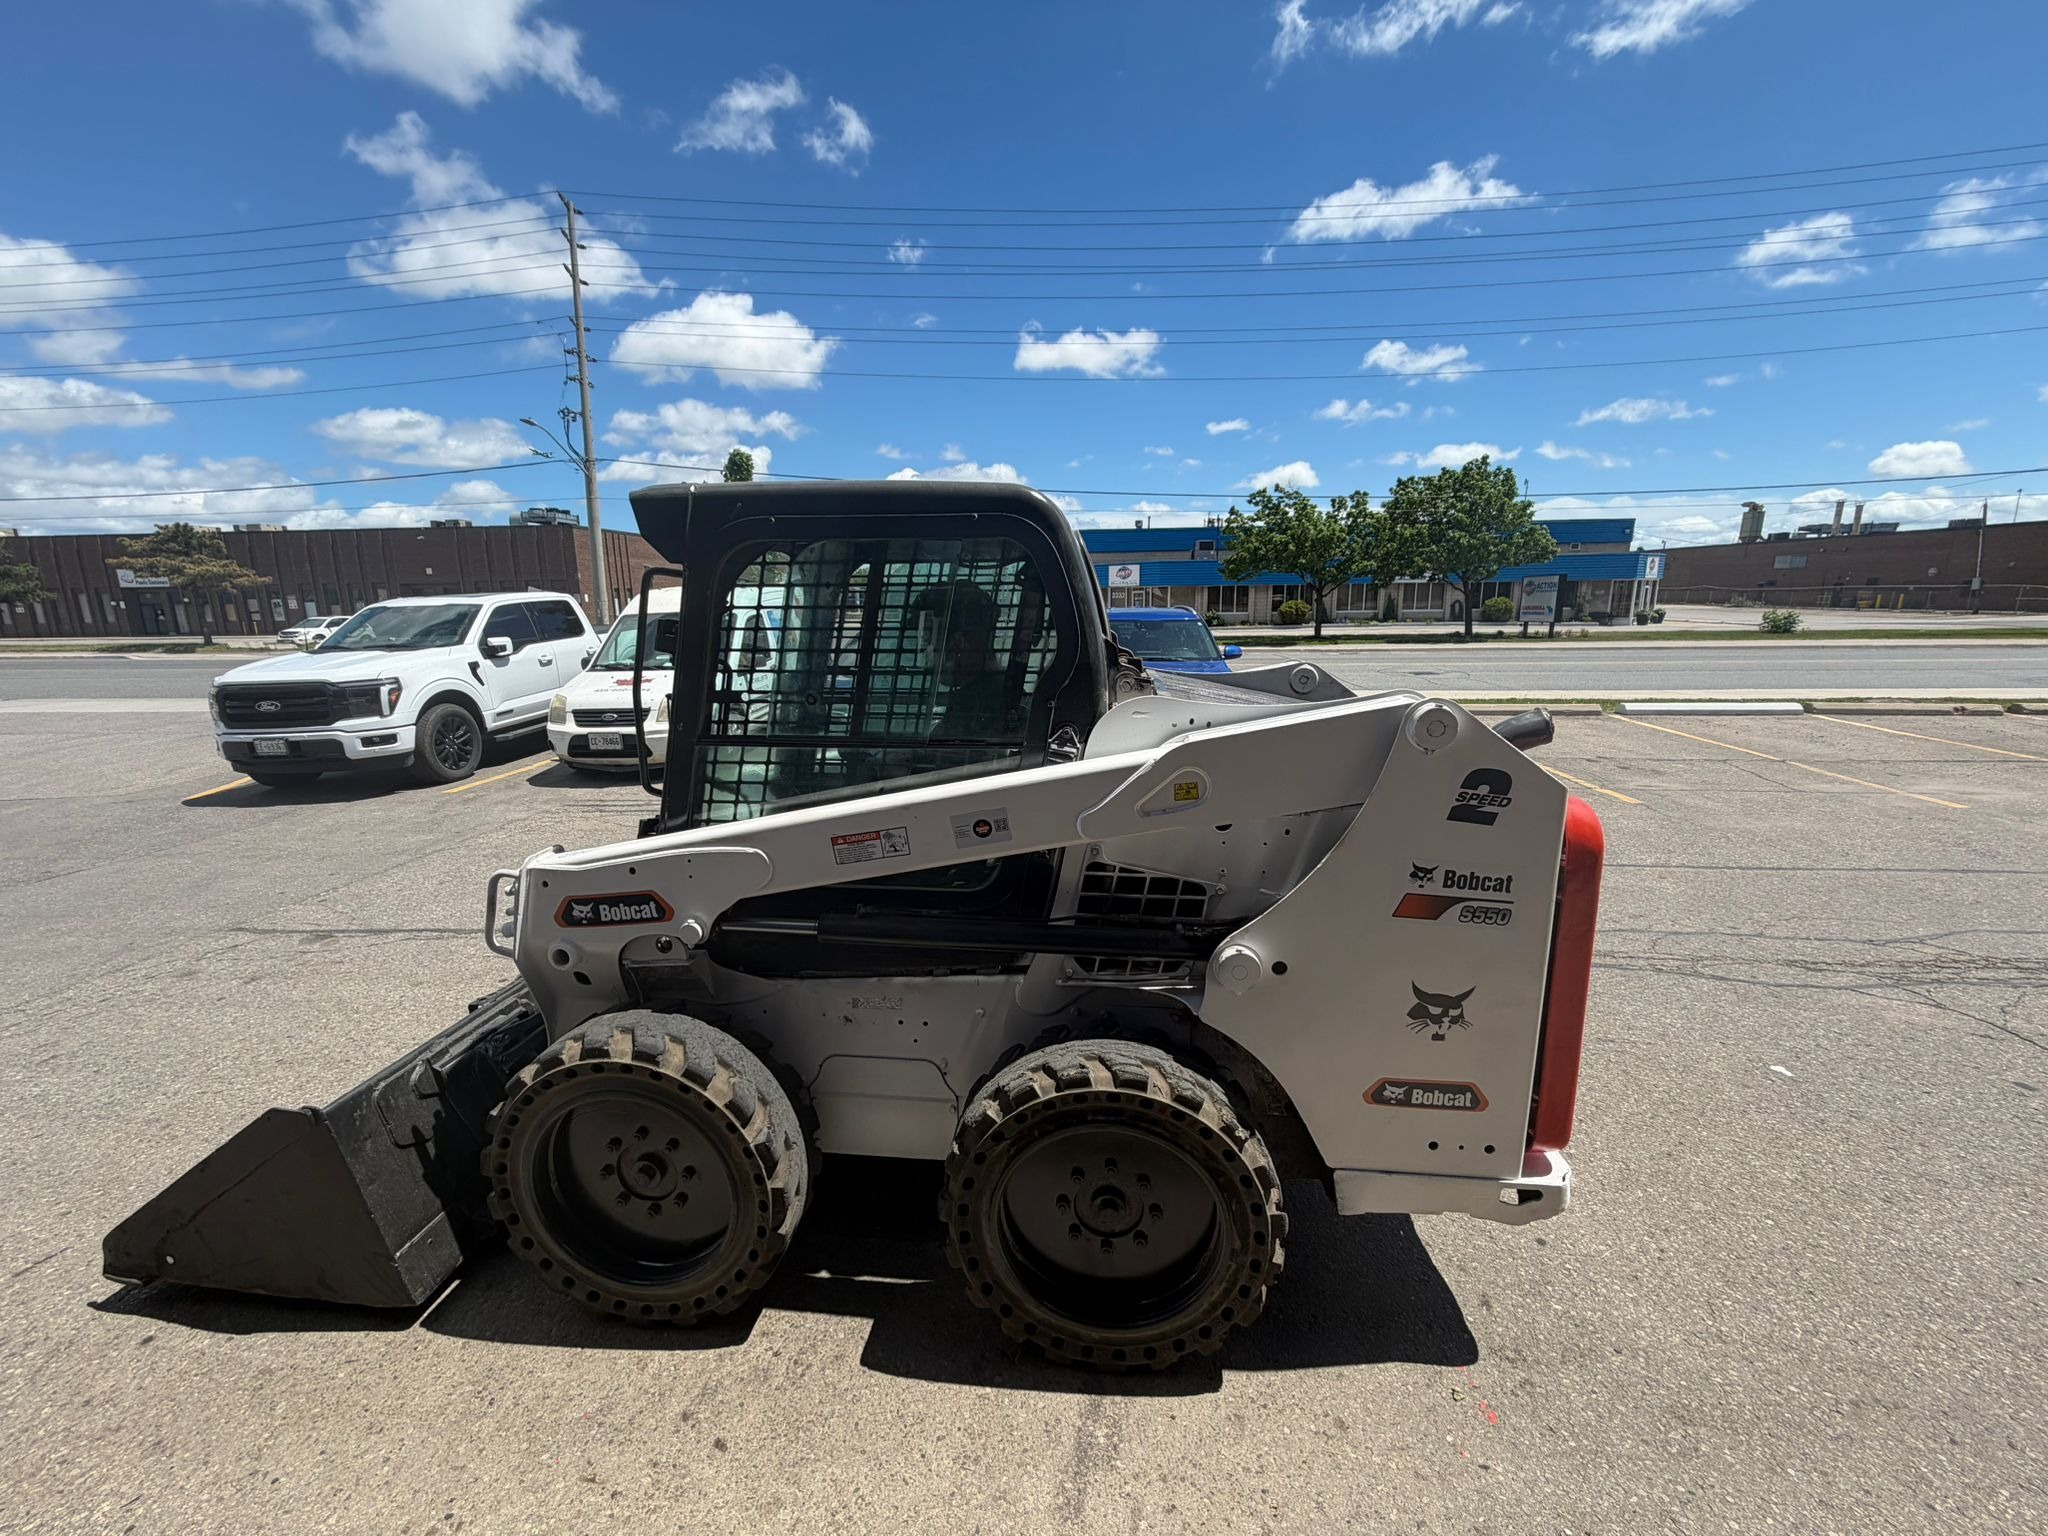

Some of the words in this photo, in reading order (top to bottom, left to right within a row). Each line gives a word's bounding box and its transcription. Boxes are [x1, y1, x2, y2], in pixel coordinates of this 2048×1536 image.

[1446, 768, 1513, 826] 2
[1455, 791, 1512, 808] SPEED
[846, 833, 877, 843] DANGER
[1442, 869, 1513, 893] Bobcat
[599, 901, 658, 921] Bobcat
[1458, 905, 1512, 926] S550
[1411, 1088, 1472, 1107] Bobcat
